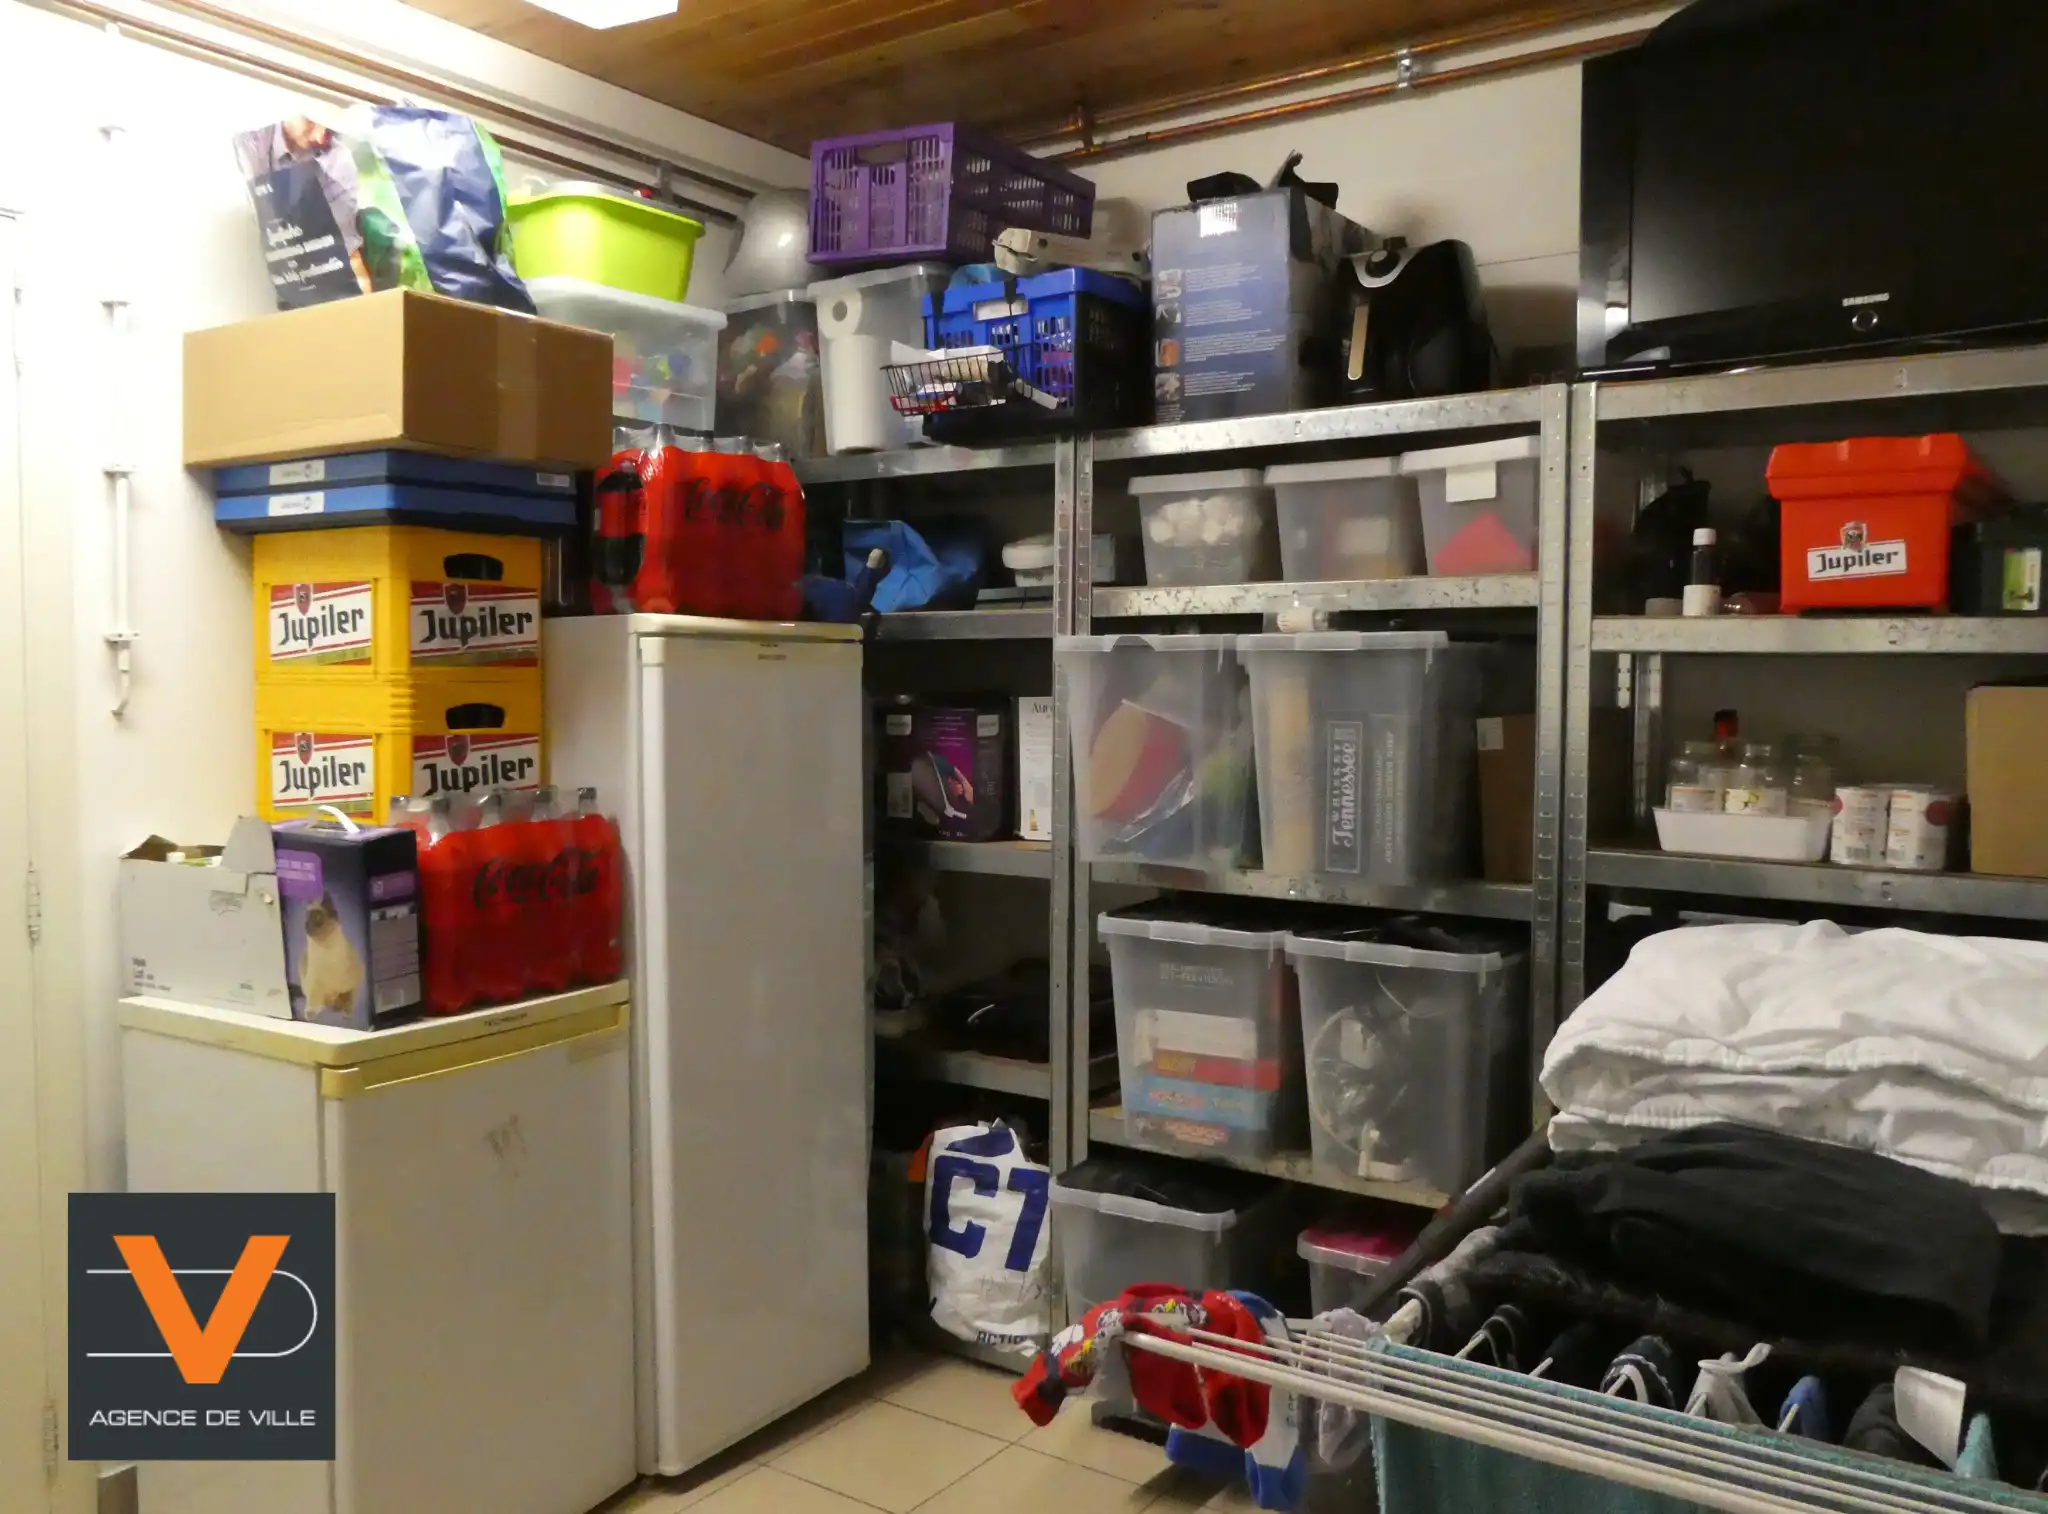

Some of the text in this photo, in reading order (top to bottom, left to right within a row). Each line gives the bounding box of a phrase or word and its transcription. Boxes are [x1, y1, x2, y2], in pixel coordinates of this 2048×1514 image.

[1815, 549, 1899, 573] Jupiler
[278, 604, 364, 648] Jupiler
[419, 605, 532, 647] Jupiler
[279, 755, 366, 797] Jupiler
[421, 753, 534, 797] Jupiler
[1332, 742, 1356, 848] Tennessee
